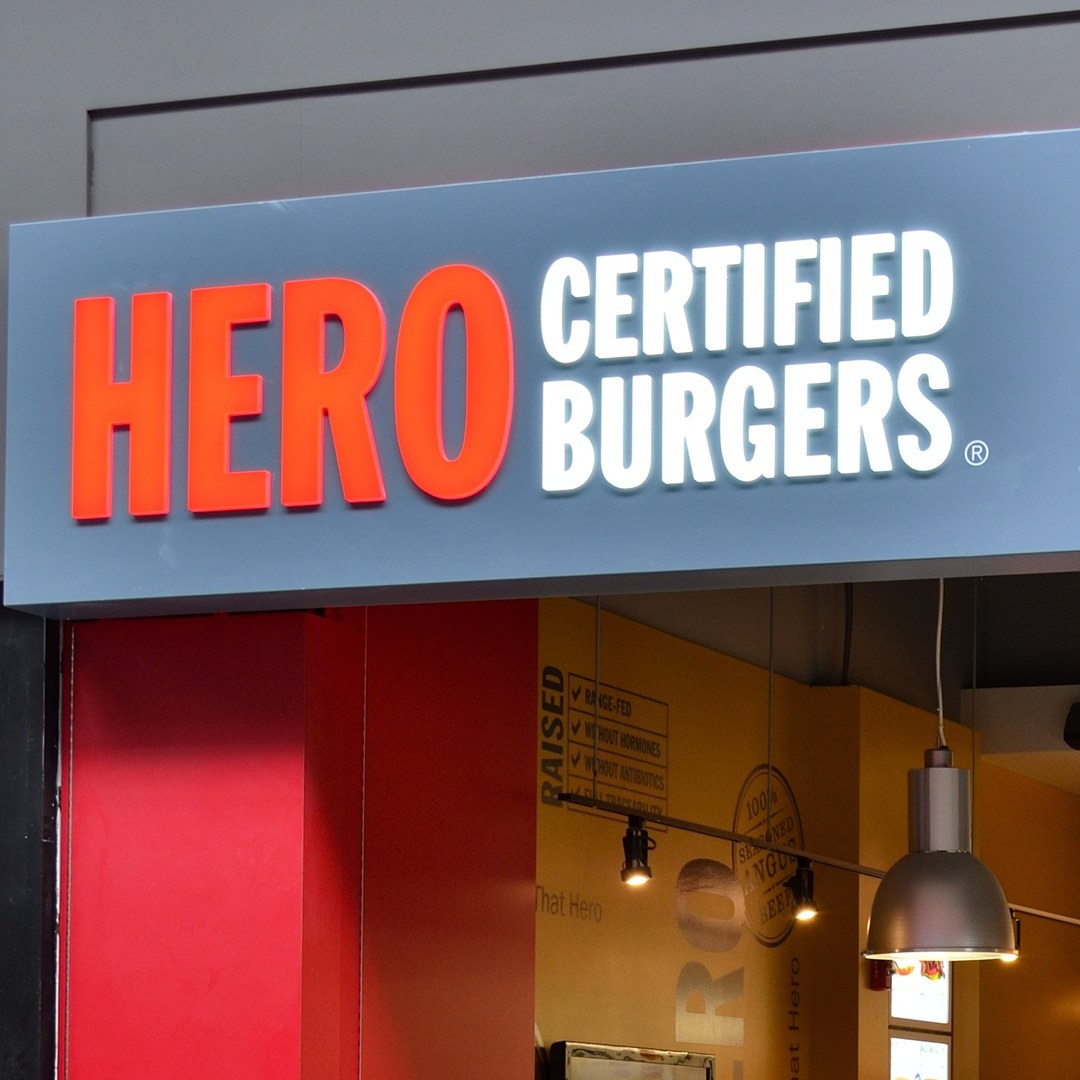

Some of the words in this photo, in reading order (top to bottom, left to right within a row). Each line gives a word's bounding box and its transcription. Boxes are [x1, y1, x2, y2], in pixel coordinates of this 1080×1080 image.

[540, 230, 954, 364] CERTIFIED
[70, 263, 514, 520] HERO
[542, 354, 952, 493] BURGERS
[541, 666, 563, 807] RAISED
[585, 689, 632, 717] RANGE-FED
[620, 733, 661, 758] HORMONES
[620, 763, 663, 791] ANTIBIOTICS
[536, 885, 565, 918] That
[569, 890, 603, 923] Hero
[789, 957, 799, 1031] Hero
